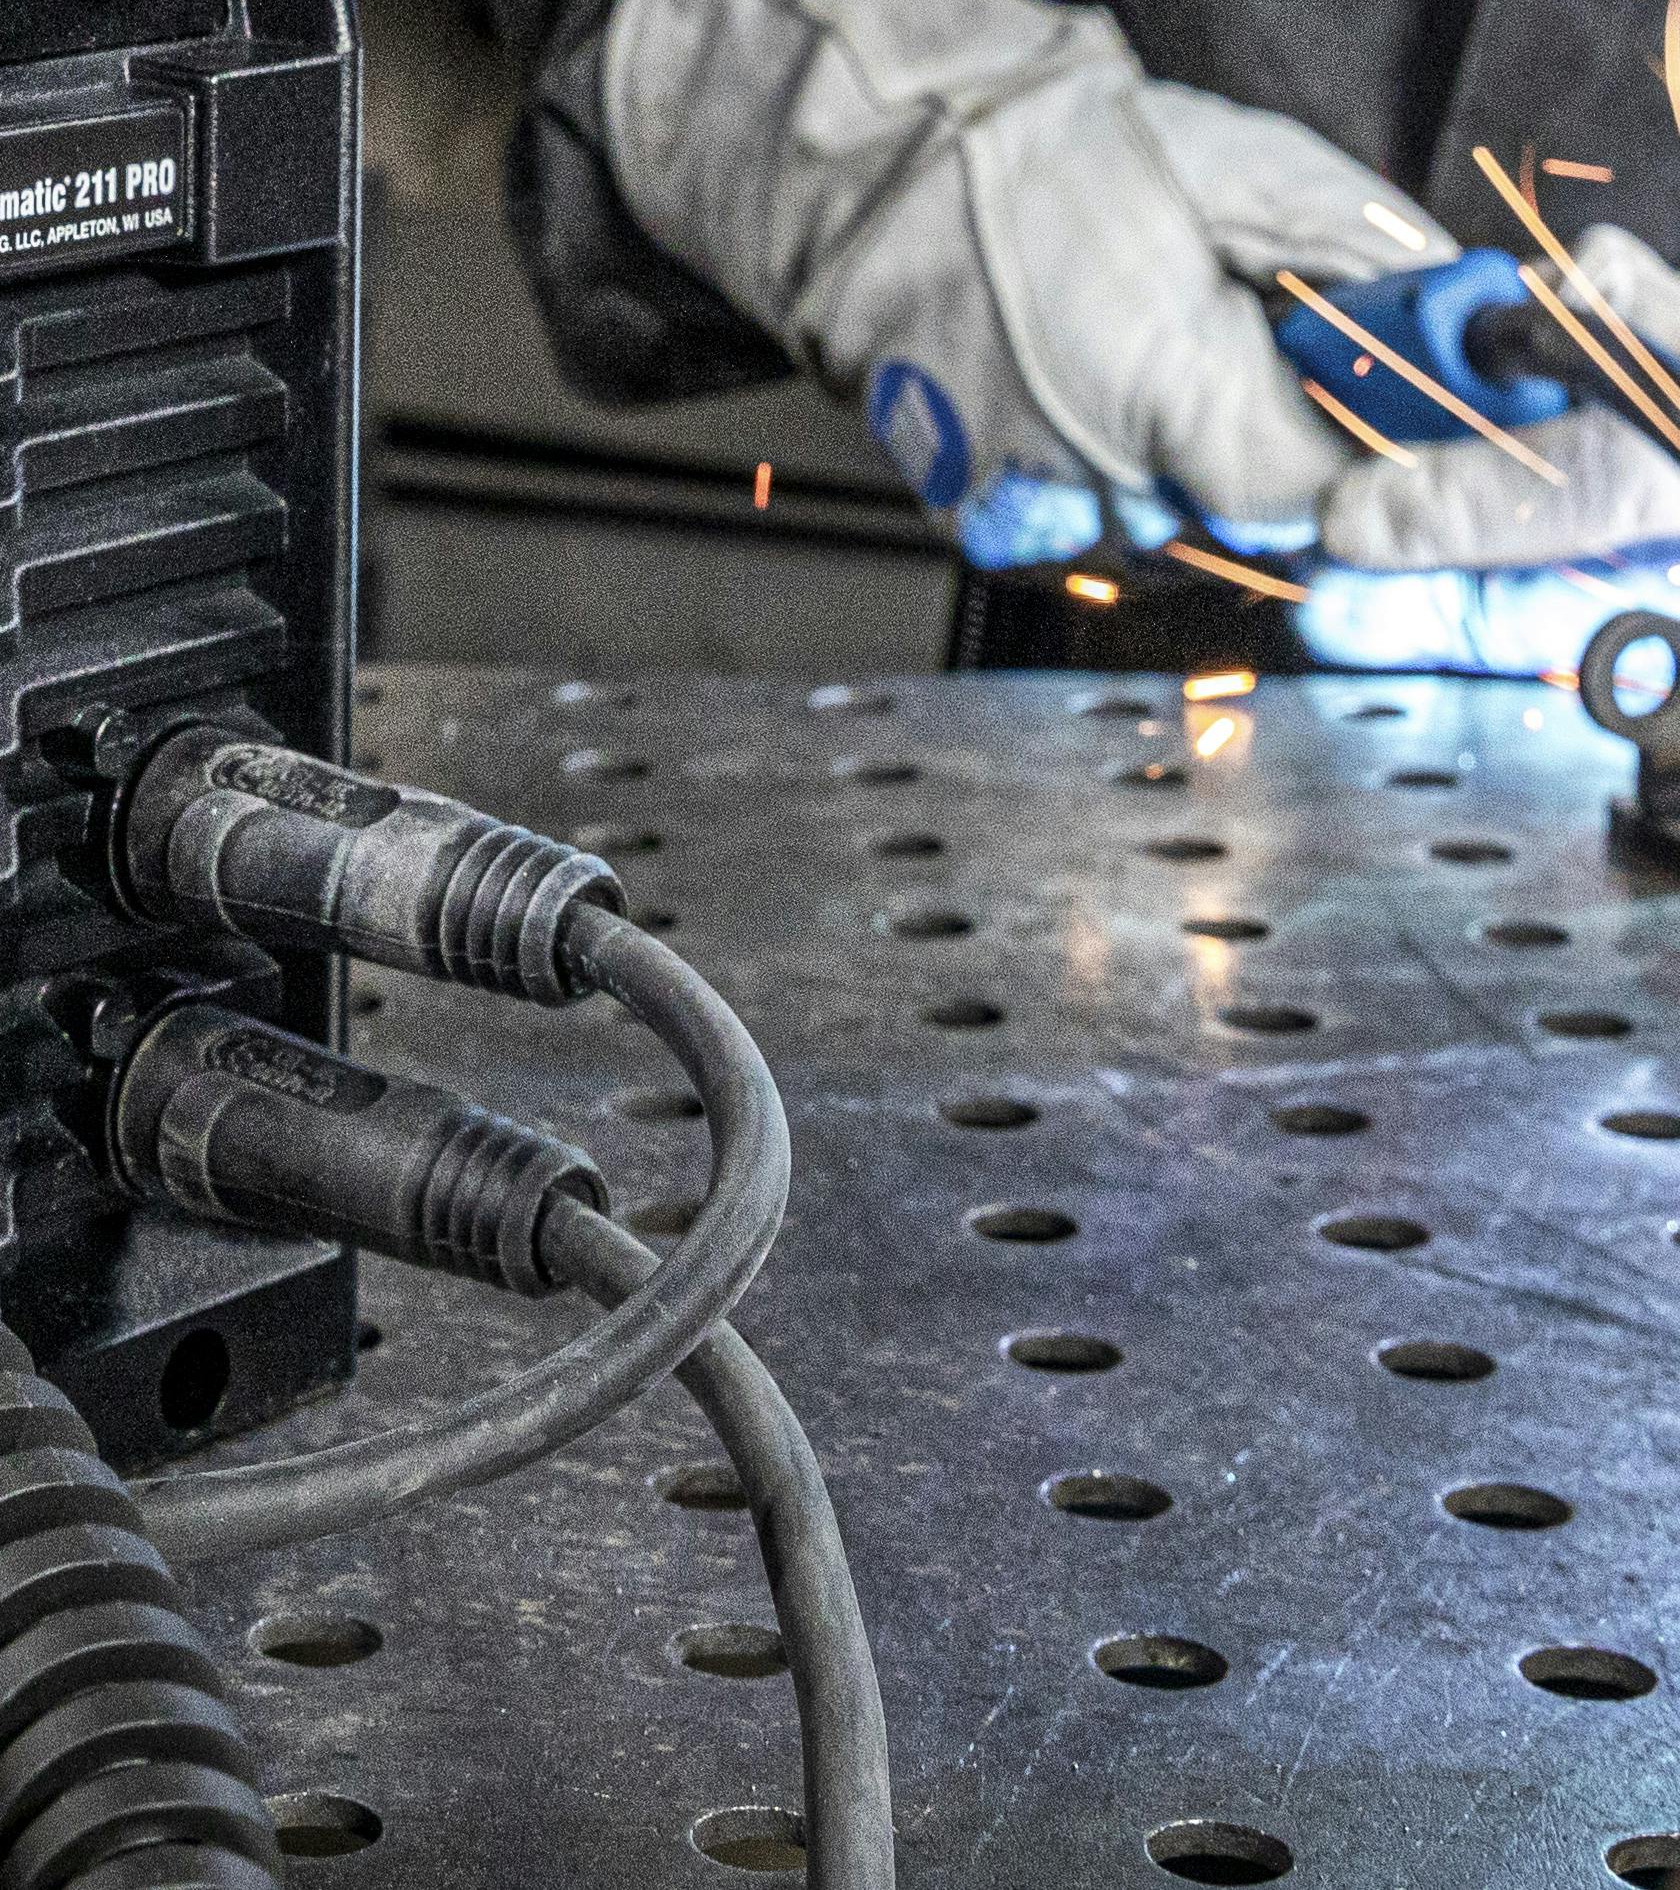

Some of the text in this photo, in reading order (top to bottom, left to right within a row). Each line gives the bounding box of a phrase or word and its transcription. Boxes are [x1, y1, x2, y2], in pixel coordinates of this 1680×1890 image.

[75, 167, 117, 210] 211
[125, 158, 176, 200] PRO
[46, 216, 121, 246] APPLETON,
[121, 212, 139, 233] WI
[144, 207, 173, 229] USA
